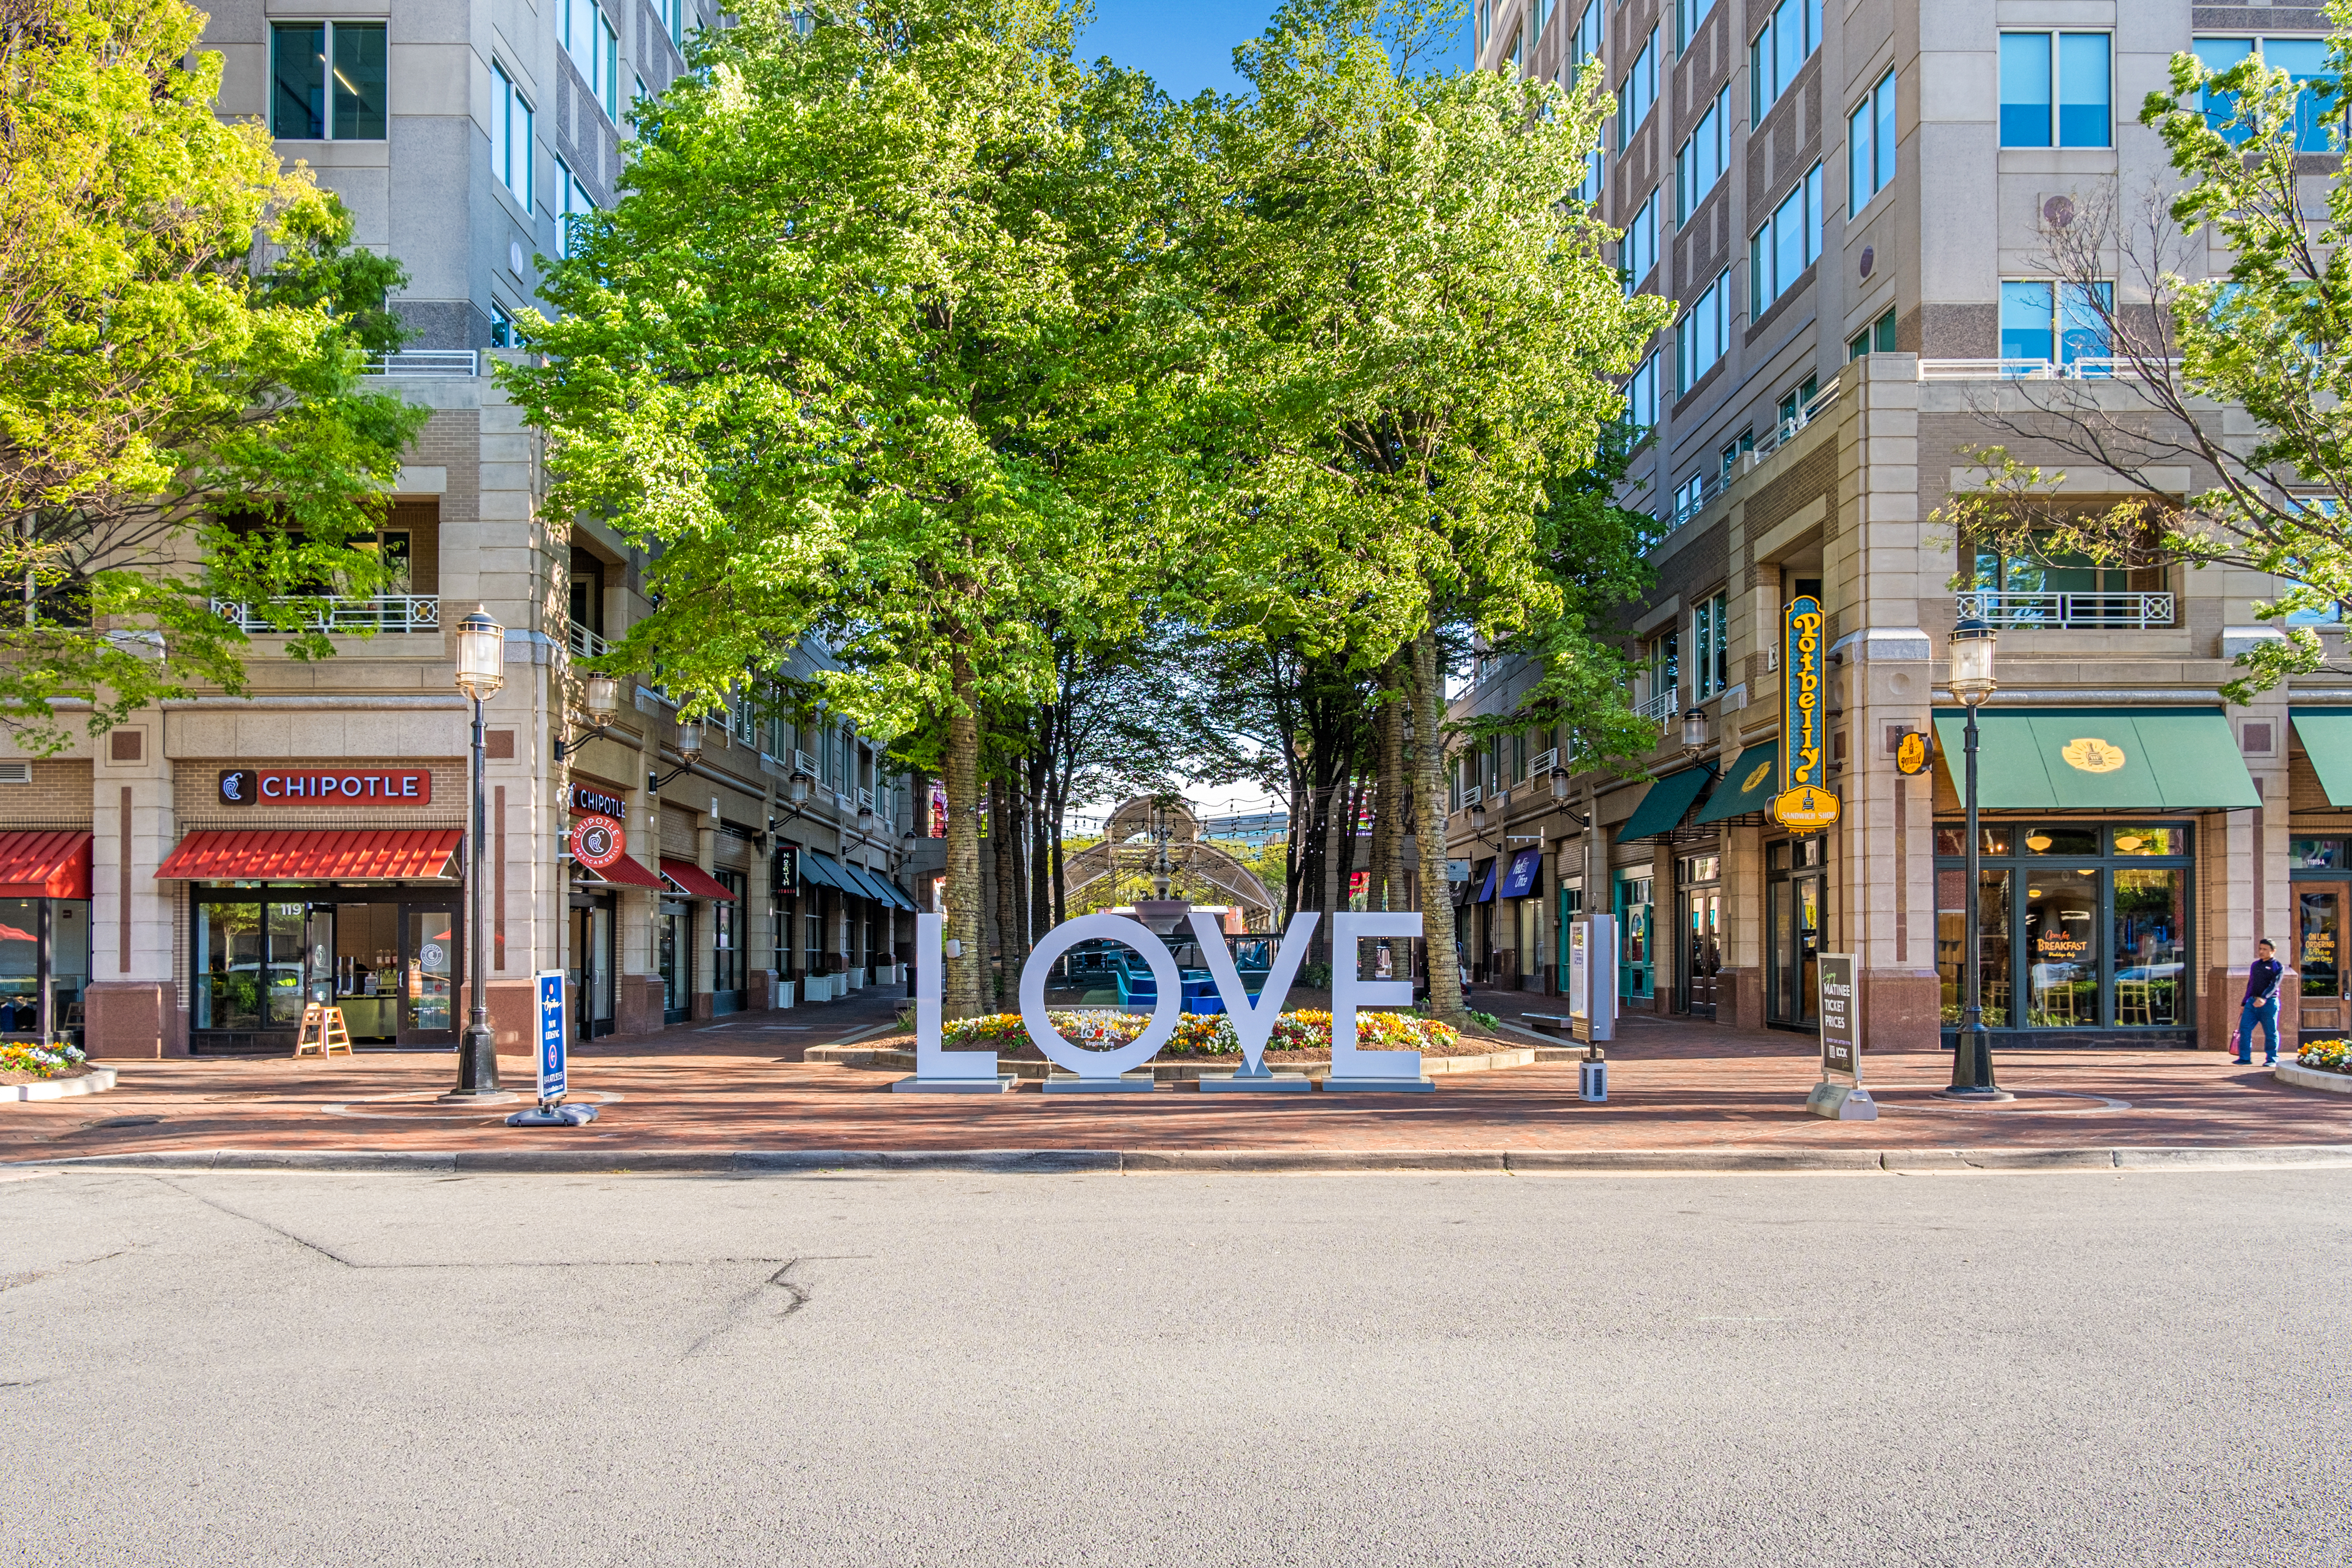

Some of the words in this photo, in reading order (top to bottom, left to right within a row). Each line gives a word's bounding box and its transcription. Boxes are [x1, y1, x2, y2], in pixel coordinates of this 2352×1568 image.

[1793, 613, 1822, 783] Potbelly
[1901, 752, 1921, 768] POTBELLY
[262, 776, 418, 797] CHIPOTLE
[580, 789, 626, 818] CHIPOTLE
[1818, 811, 1835, 820] SHOP
[573, 817, 620, 838] CHIPOTLE
[575, 848, 603, 865] MEXICAN
[604, 845, 620, 862] GRILL
[1513, 857, 1529, 874] FedEx
[1515, 874, 1528, 888] Office
[2045, 930, 2060, 941] Open
[423, 945, 441, 954] CHIPOTLE
[2037, 939, 2087, 952] BREAKFAST
[917, 912, 1422, 1079] LOVE
[1823, 983, 1850, 997] MATINEE
[1825, 999, 1845, 1012] TICKET
[1071, 1009, 1121, 1018] VIRGINIA
[1092, 1019, 1114, 1029] FOR
[1825, 1014, 1845, 1029] PRICES
[545, 1029, 560, 1040] LEASING
[1836, 1047, 1847, 1058] LOOK
